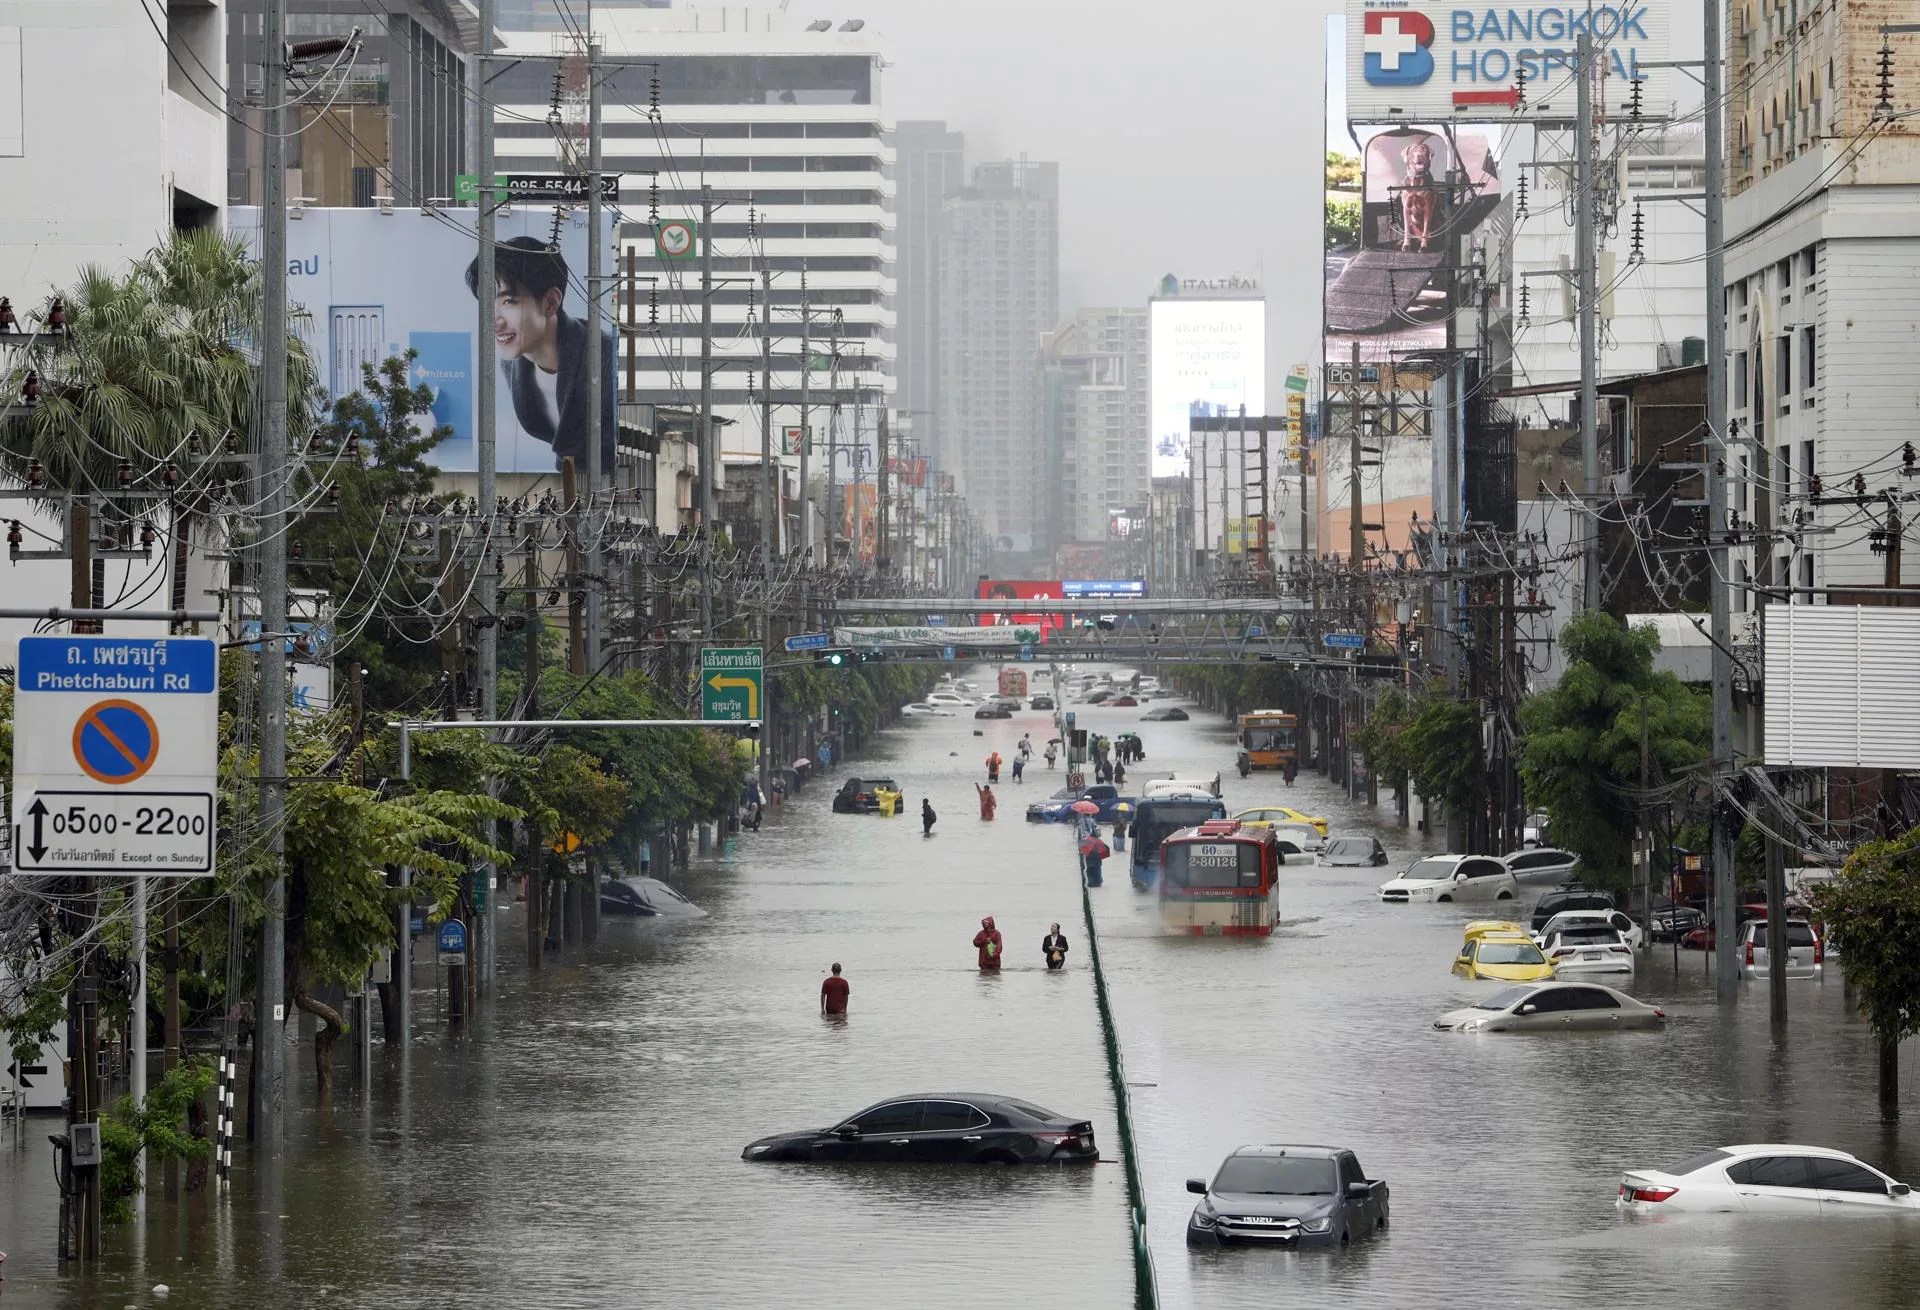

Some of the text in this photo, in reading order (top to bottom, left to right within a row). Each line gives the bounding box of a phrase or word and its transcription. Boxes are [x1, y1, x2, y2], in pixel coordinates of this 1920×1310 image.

[1451, 7, 1649, 42] BANGKOK
[509, 180, 617, 196] 085-5544-22
[1183, 279, 1256, 290] ITALTHAI
[67, 641, 168, 672] ถ. เพชรบุรี
[704, 651, 761, 667] เส้นทางลัด
[37, 672, 190, 690] Phetchaburi Rd
[730, 712, 742, 720] 55
[51, 848, 116, 863] เว้นวันอาทิตย์
[1201, 844, 1217, 856] 60
[121, 852, 205, 865] Except on Sunday
[1189, 857, 1238, 868] 2-80126
